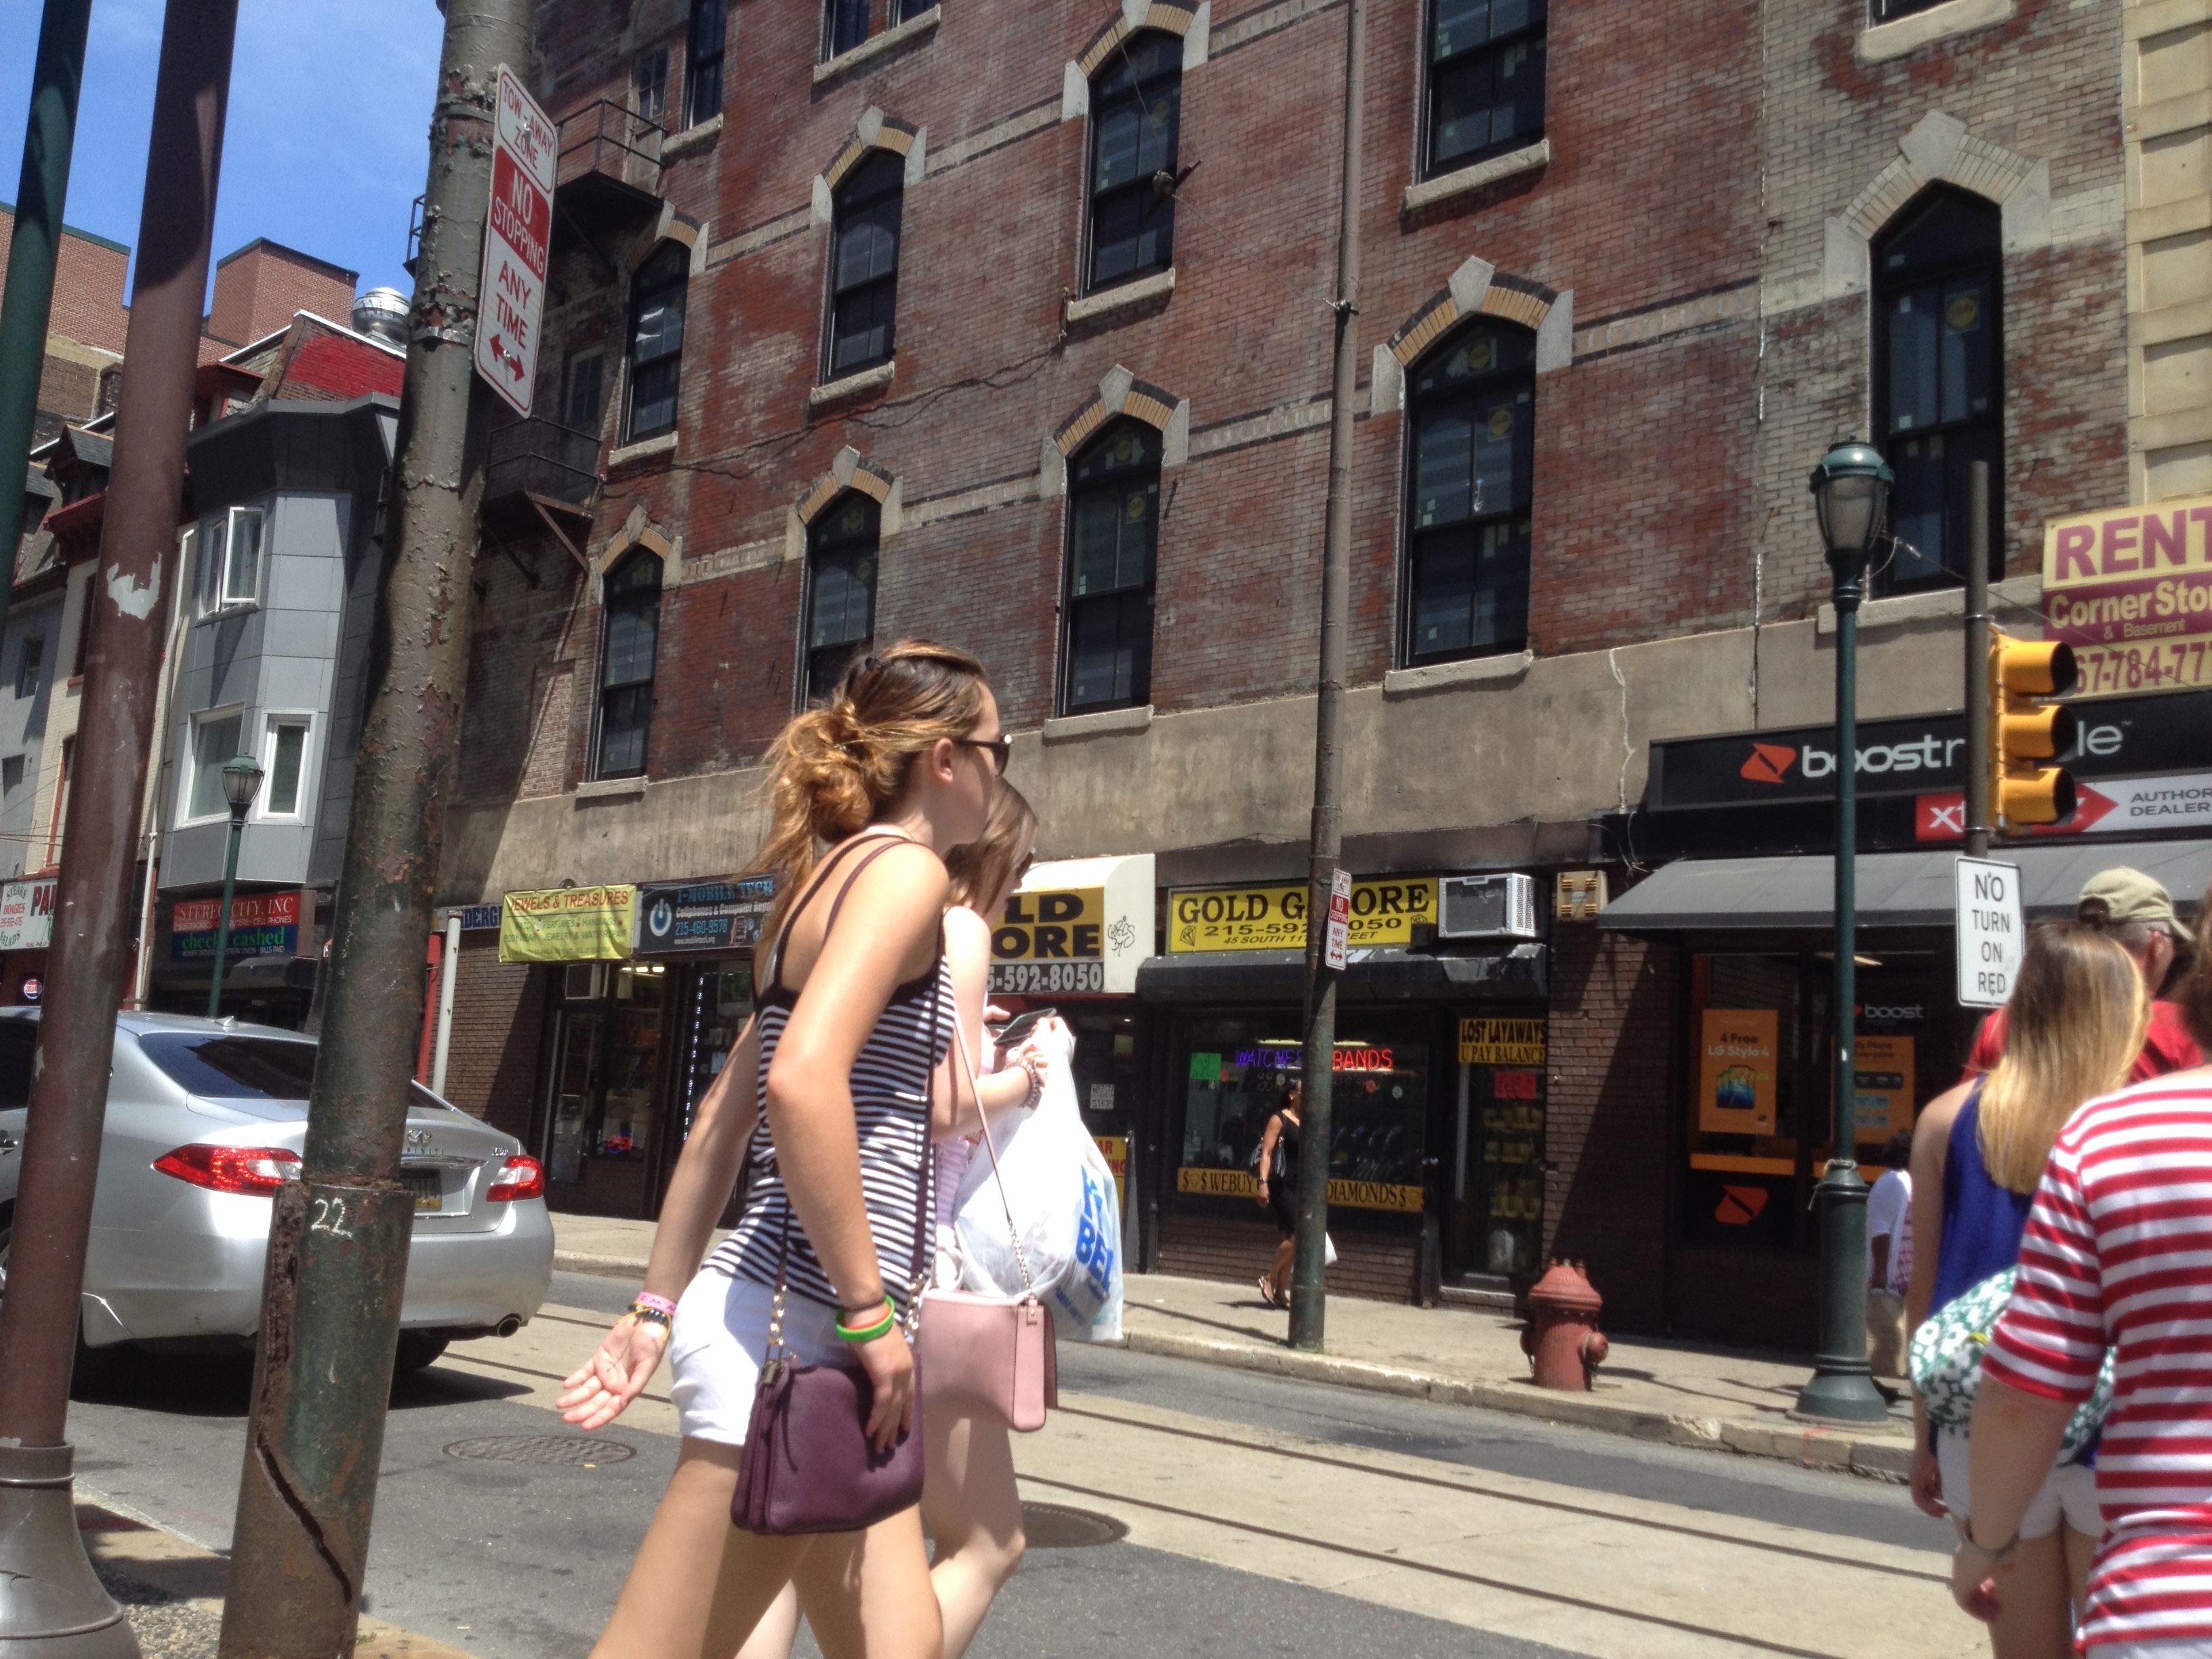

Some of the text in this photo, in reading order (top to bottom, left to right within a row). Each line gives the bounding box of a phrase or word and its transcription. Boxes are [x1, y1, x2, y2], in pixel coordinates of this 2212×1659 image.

[515, 125, 539, 170] ZONE
[512, 169, 533, 225] NO
[495, 197, 545, 274] STOPPING
[498, 260, 532, 310] ANY
[496, 293, 529, 350] TIME
[2055, 507, 2212, 581] RENT
[2049, 592, 2152, 629] Corner
[2104, 619, 2186, 640] & Basement
[2074, 641, 2212, 694] 67-784-77
[2130, 802, 2211, 817] DEALER
[1975, 874, 2004, 902] NO
[268, 897, 293, 915] INC
[510, 890, 629, 912] JEWELS & TREASURES
[720, 903, 753, 915] Computer
[1004, 893, 1084, 924] LD
[1179, 894, 1269, 924] GOLD
[1336, 898, 1344, 912] NO
[217, 919, 249, 928] CPUTERS
[268, 916, 292, 924] PHONES
[543, 920, 575, 929] PERFUMES
[1971, 909, 2010, 933] TURN
[182, 926, 285, 949] check cashed
[991, 924, 1099, 959] ORE
[1332, 927, 1343, 938] ANY
[1332, 939, 1343, 950] TIME
[1982, 941, 2002, 962] ON
[987, 964, 1102, 991] 5-592-8050
[1978, 972, 2006, 994] RED
[1865, 1004, 1924, 1019] boost
[1461, 1021, 1486, 1043] LOST
[1720, 1033, 1758, 1044] 4 Free
[1332, 1050, 1394, 1071] BANDS
[1461, 1046, 1545, 1063] U PAY BALANCE
[1708, 1045, 1769, 1059] LG Stylo 4
[1098, 1140, 1113, 1154] AR
[1328, 1181, 1397, 1204] DIAMONDS
[311, 1197, 352, 1238] 22
